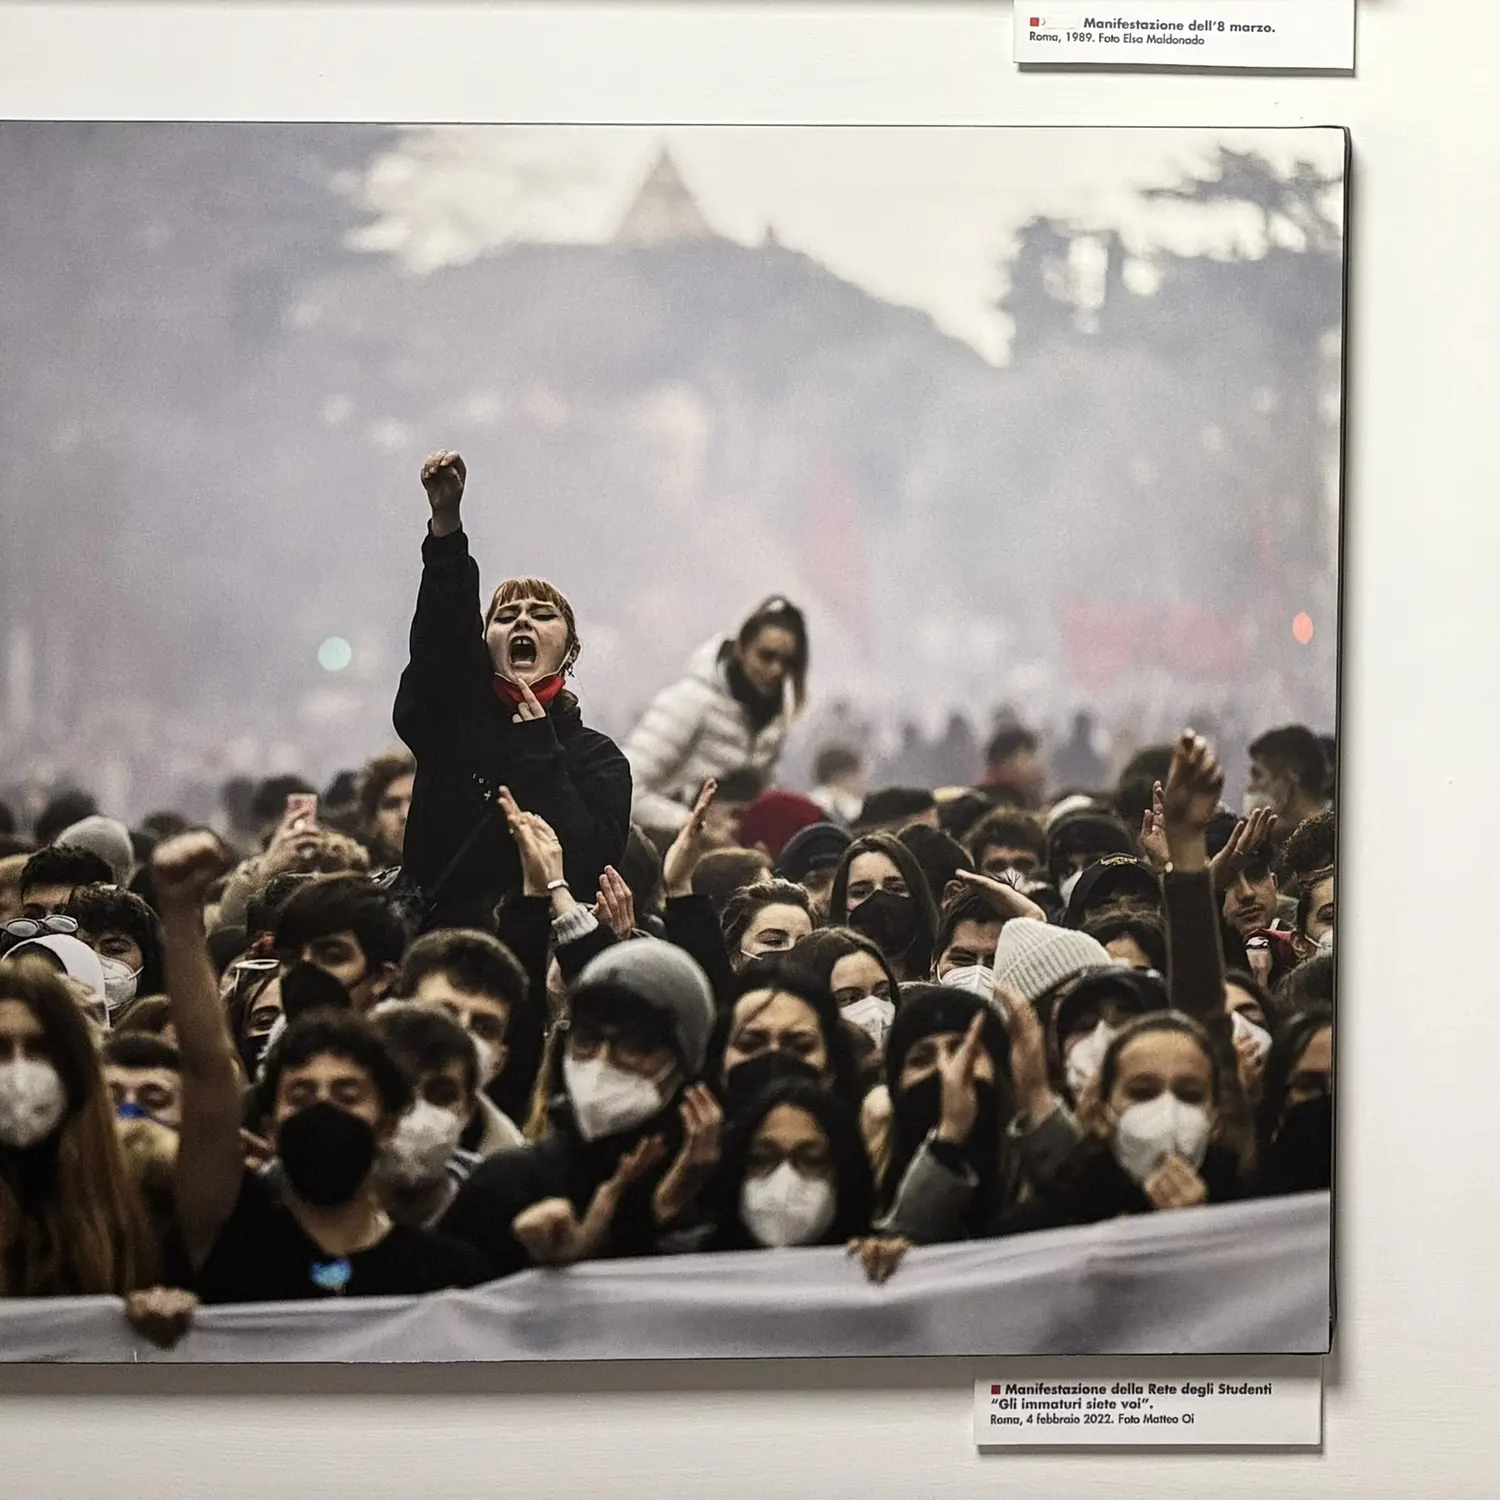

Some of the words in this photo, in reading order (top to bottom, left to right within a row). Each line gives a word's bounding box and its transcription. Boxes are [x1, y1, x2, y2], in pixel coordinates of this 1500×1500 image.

[1083, 17, 1185, 31] Manifestazione
[1229, 23, 1276, 33] marzo.
[1029, 31, 1061, 44] Roma,
[1066, 32, 1096, 43] 1989.
[1098, 32, 1121, 44] Foto
[1123, 32, 1143, 44] Elsa
[1146, 33, 1205, 45] Maldonado
[1005, 1383, 1107, 1396] Manifestazione
[1110, 1382, 1144, 1395] della
[1148, 1383, 1178, 1395] Rete
[1181, 1382, 1214, 1398] degli
[1218, 1382, 1272, 1395] Studenti
[1021, 1398, 1082, 1410] immaturi
[1086, 1398, 1116, 1410] siete
[990, 1414, 1023, 1426] Roma,
[1026, 1414, 1034, 1425] 4
[1036, 1412, 1080, 1424] febbraio
[1083, 1414, 1115, 1425] 2022.
[1118, 1413, 1140, 1425] Foto
[1143, 1413, 1179, 1424] Matteo
[1181, 1412, 1195, 1424] Oi
